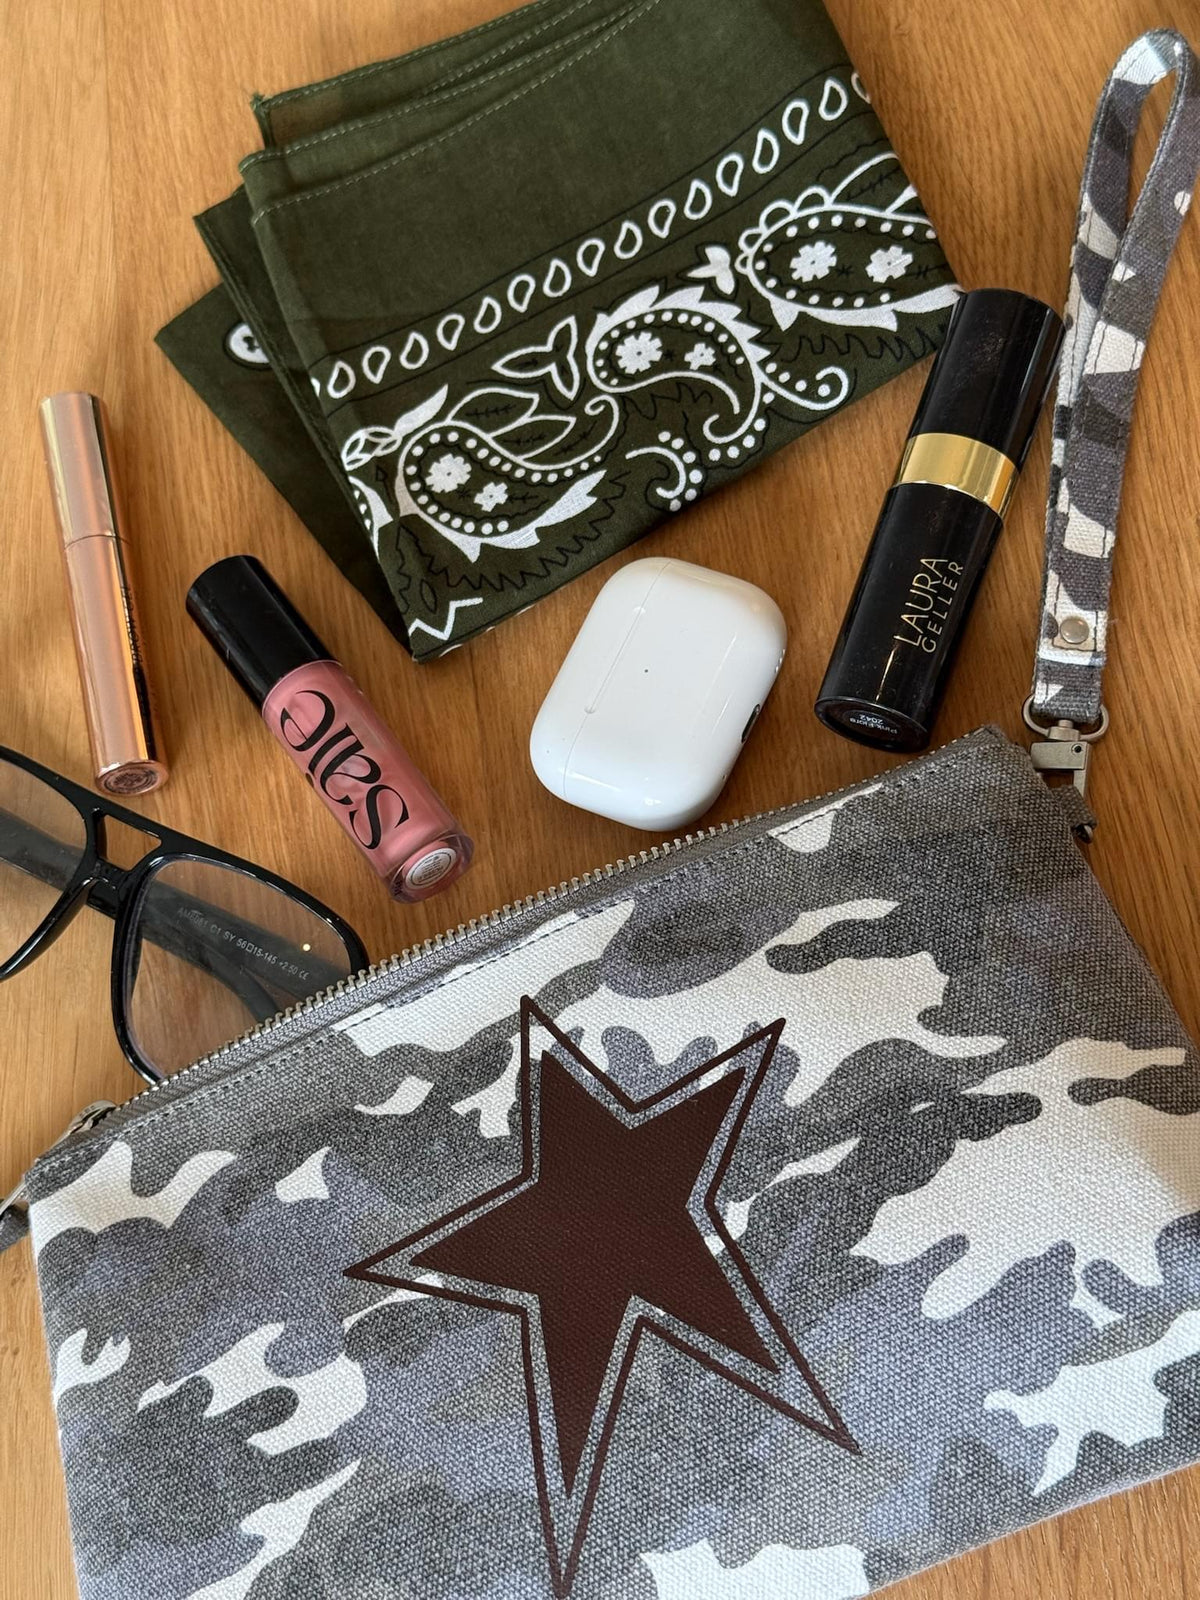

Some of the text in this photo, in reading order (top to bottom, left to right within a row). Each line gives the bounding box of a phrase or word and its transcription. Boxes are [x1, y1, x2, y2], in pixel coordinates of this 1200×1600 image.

[893, 558, 949, 647] LAURA
[921, 561, 964, 653] GELLER
[859, 714, 884, 725] 2042
[280, 689, 410, 850] saie
[223, 930, 236, 942] SY
